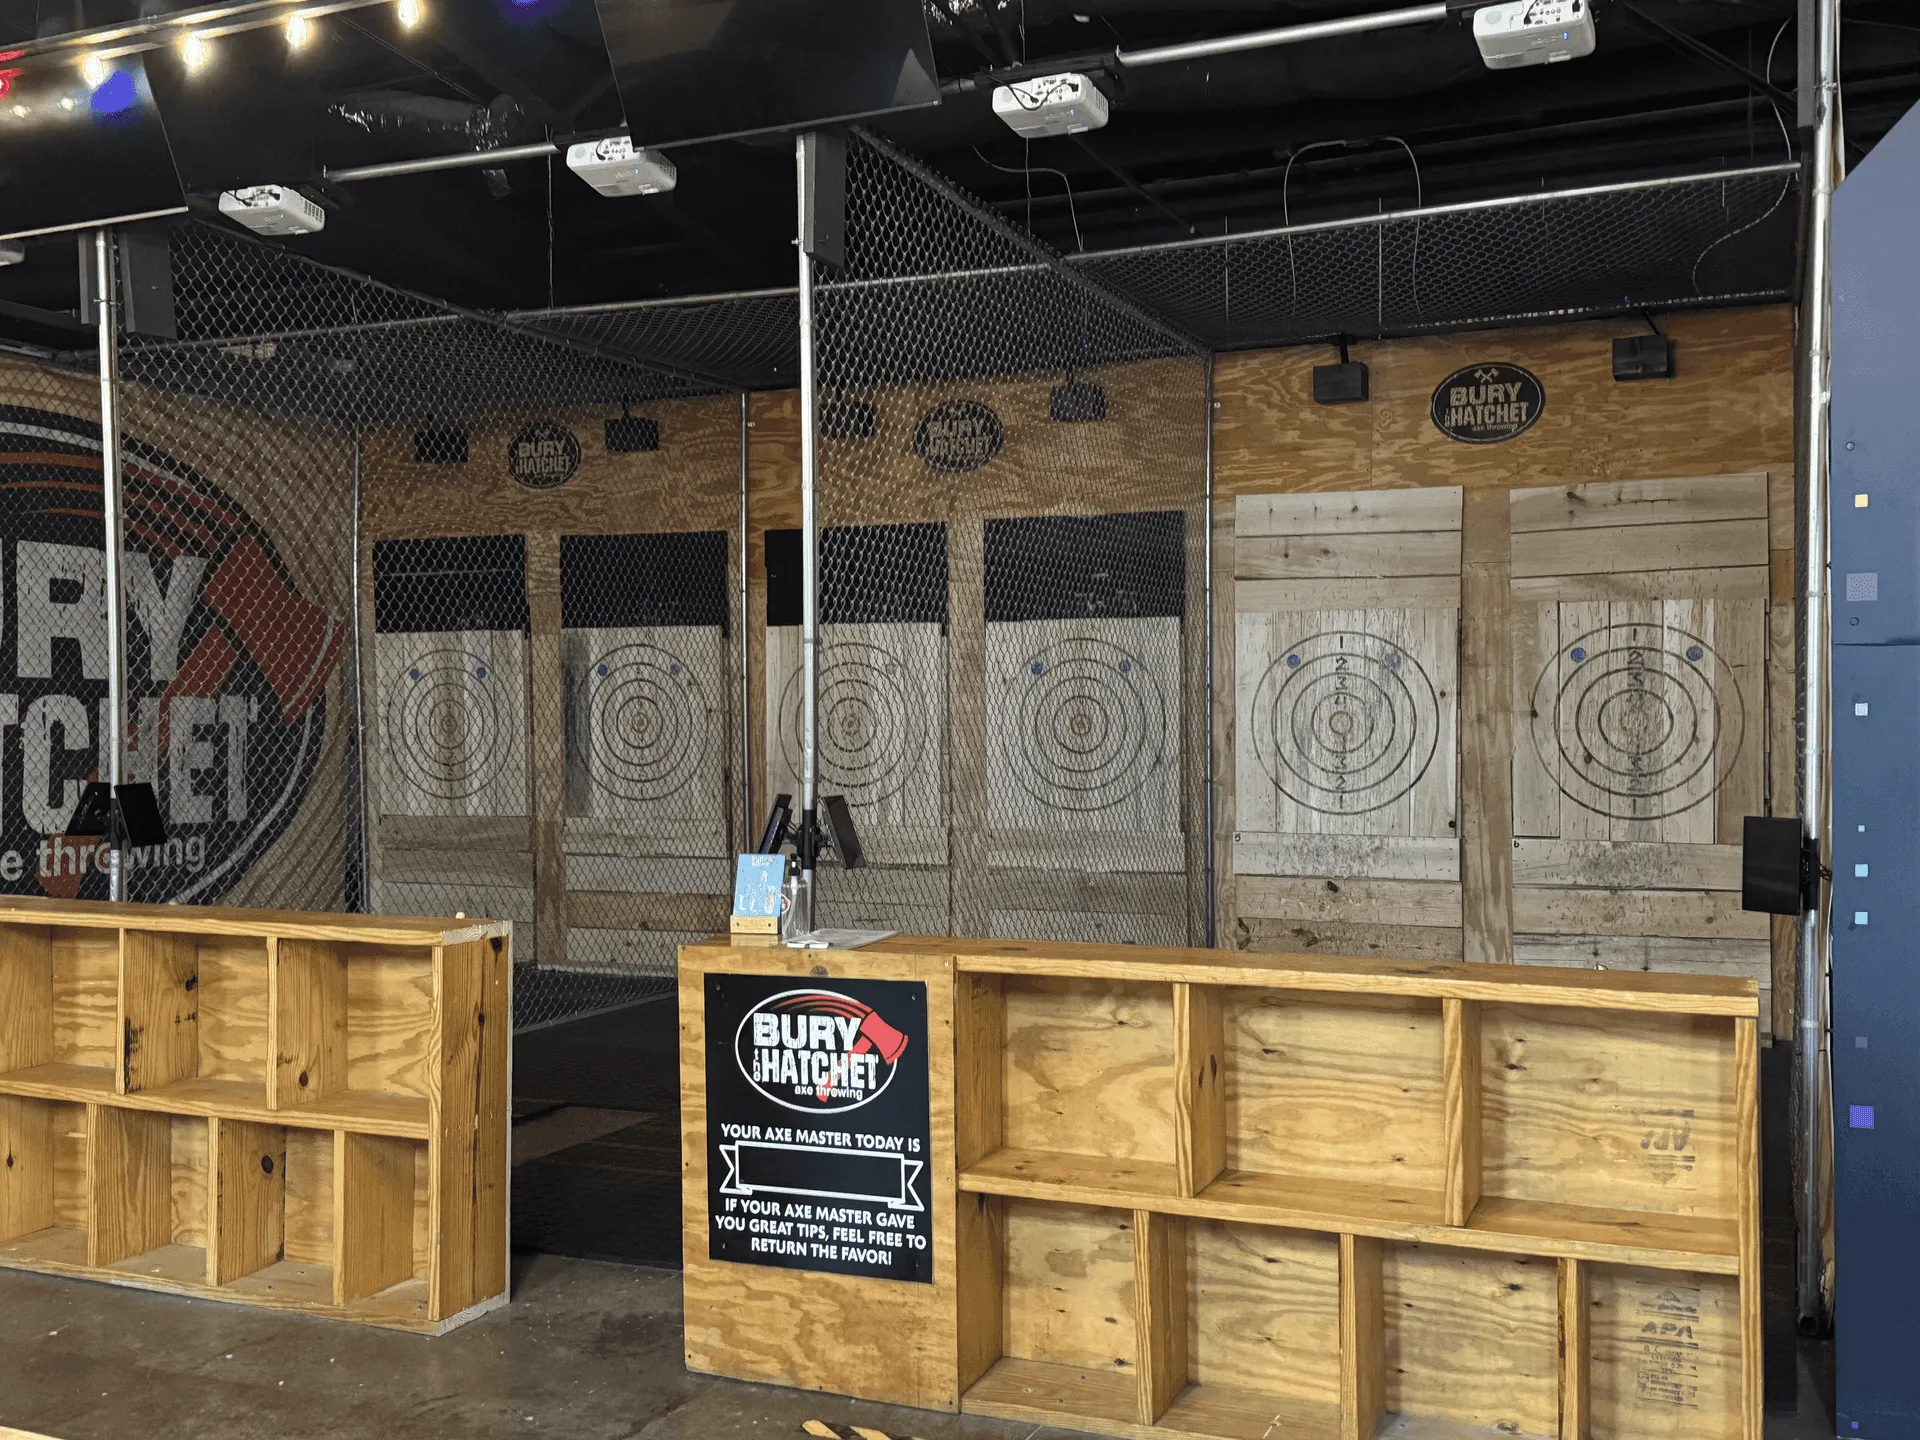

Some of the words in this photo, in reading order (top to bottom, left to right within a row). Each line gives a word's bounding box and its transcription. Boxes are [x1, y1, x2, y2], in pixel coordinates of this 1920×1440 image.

[1449, 382, 1523, 407] BURY
[1450, 401, 1529, 427] HATCHET
[518, 439, 566, 457] BURY
[519, 455, 570, 474] HATCHET
[753, 1012, 862, 1051] BURY
[752, 1048, 762, 1083] the
[762, 1048, 879, 1090] HATCHET
[794, 1085, 813, 1096] axe
[815, 1084, 863, 1101] throwing
[721, 1123, 761, 1140] YOUR
[764, 1126, 792, 1142] AXE
[795, 1128, 851, 1147] MASTER
[855, 1133, 904, 1151] TODAY
[907, 1137, 920, 1153] IS
[725, 1197, 737, 1212] IF
[740, 1199, 781, 1216] YOUR
[784, 1202, 812, 1220] AXE
[815, 1206, 872, 1226] MASTER
[875, 1212, 915, 1230] GAVE
[715, 1214, 746, 1231] YOU
[749, 1218, 793, 1236] GREAT
[796, 1223, 830, 1242] TIPS,
[832, 1227, 864, 1244] FEEL
[868, 1230, 903, 1248] FREE
[905, 1234, 927, 1250] TO
[751, 1237, 807, 1257] RETURN
[810, 1243, 837, 1260] THE
[841, 1248, 893, 1266] FAVOR!
[1641, 1321, 1694, 1339] APA
